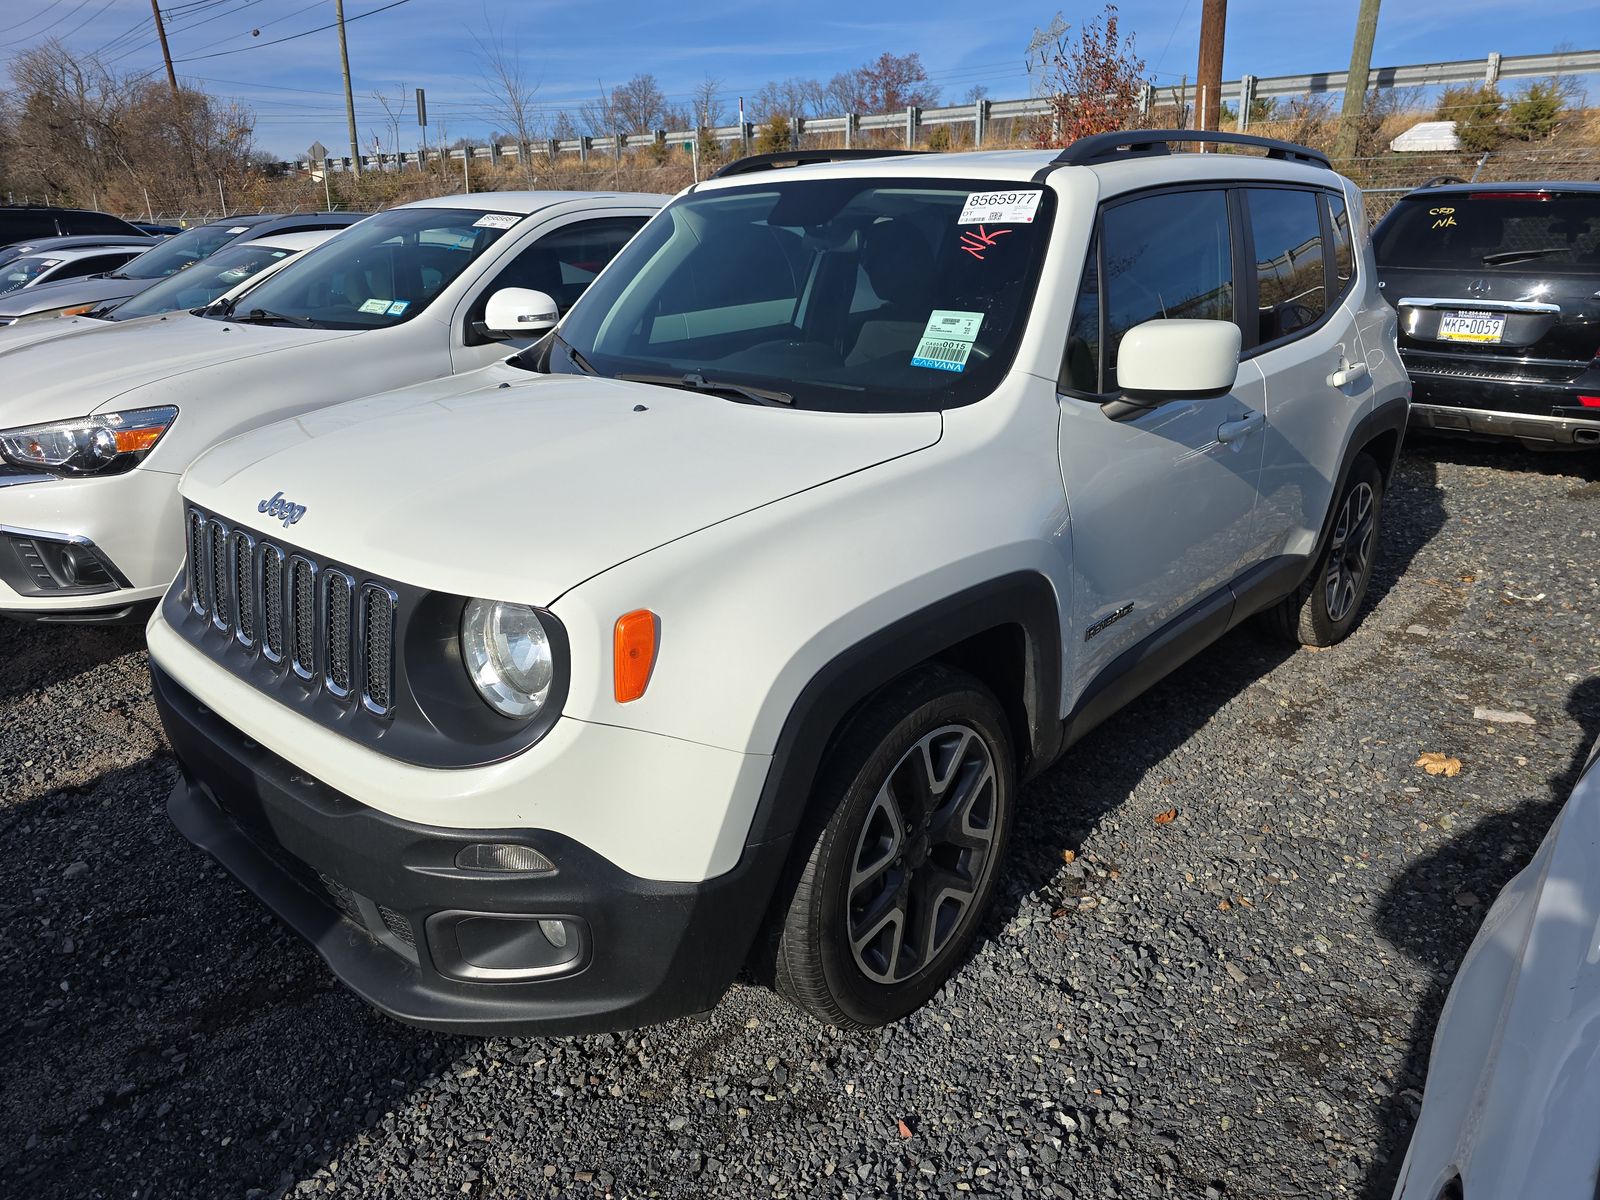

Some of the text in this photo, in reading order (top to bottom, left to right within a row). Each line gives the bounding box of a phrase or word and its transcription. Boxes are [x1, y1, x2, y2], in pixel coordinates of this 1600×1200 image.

[969, 193, 1037, 208] 8565977
[912, 358, 962, 371] CARVANA
[258, 491, 307, 528] Jeep
